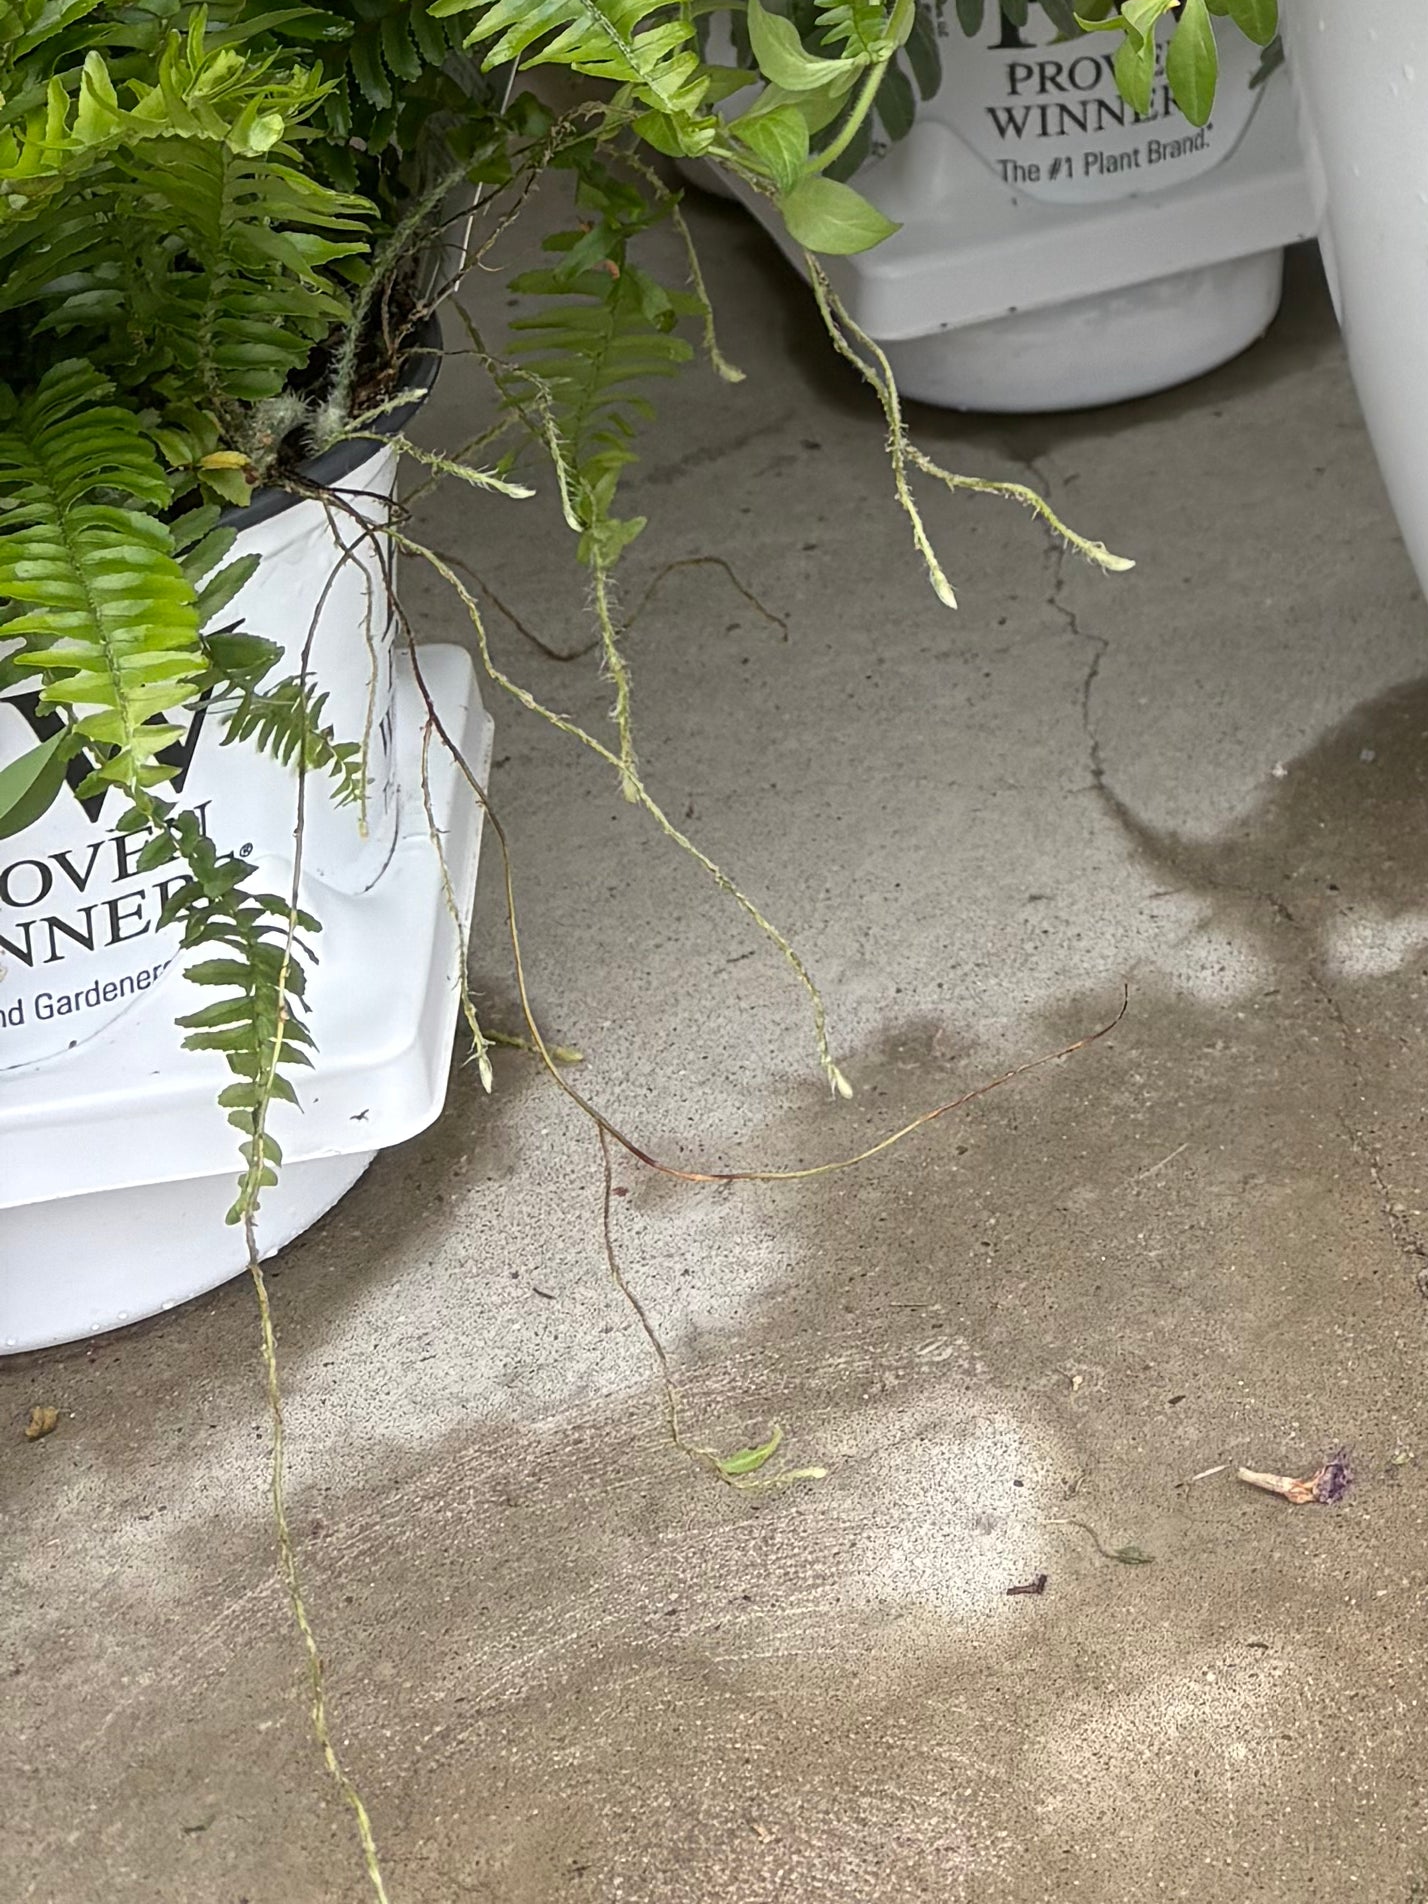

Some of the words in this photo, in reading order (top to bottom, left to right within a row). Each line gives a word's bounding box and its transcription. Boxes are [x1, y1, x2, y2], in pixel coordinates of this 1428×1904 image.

[998, 159, 1040, 184] The
[1047, 155, 1074, 181] #1
[1083, 145, 1141, 178] Plant
